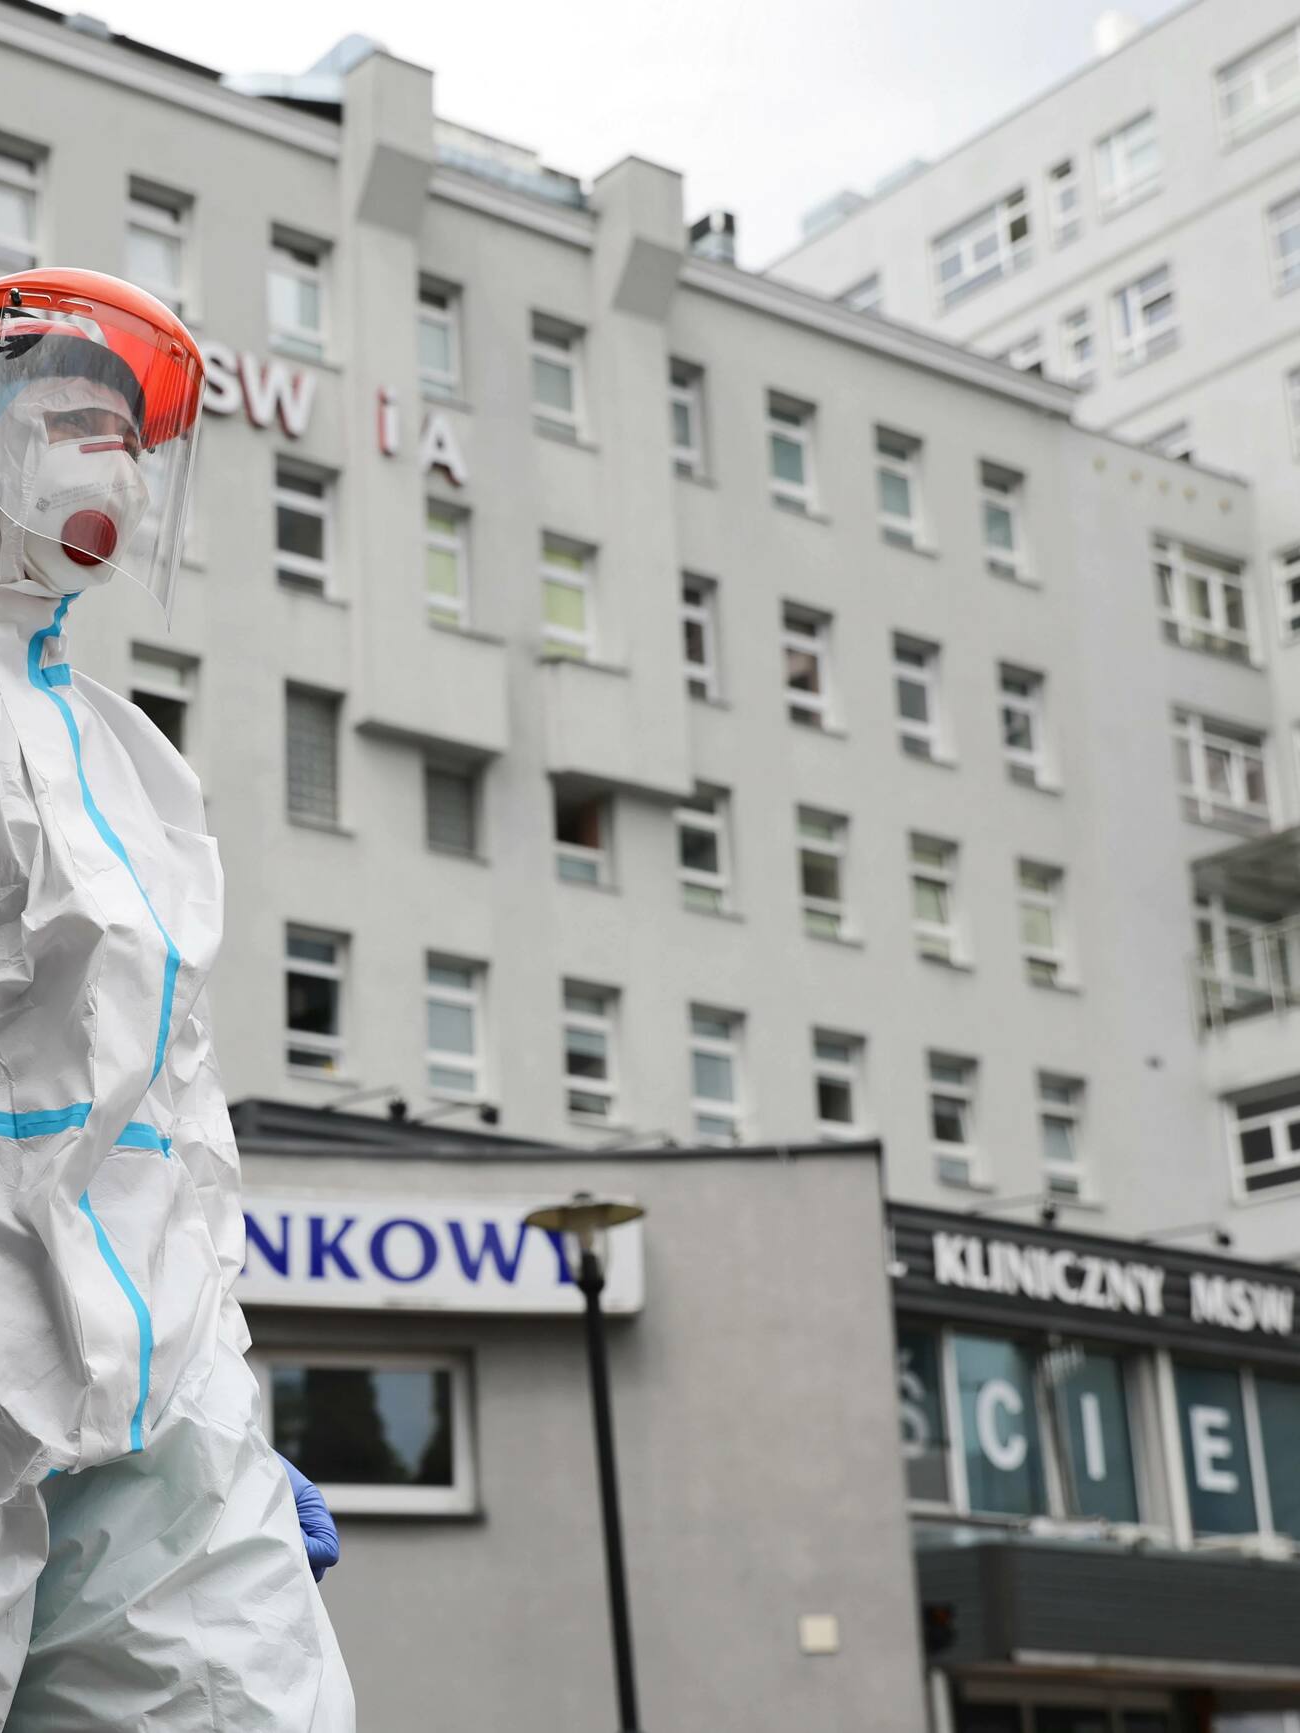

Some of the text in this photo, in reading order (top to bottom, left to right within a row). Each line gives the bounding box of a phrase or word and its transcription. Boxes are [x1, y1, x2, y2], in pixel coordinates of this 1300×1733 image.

[203, 342, 316, 440] SW
[245, 1212, 576, 1284] NKOWY
[932, 1231, 1165, 1316] KLINICZNY
[1190, 1272, 1294, 1335] MSW
